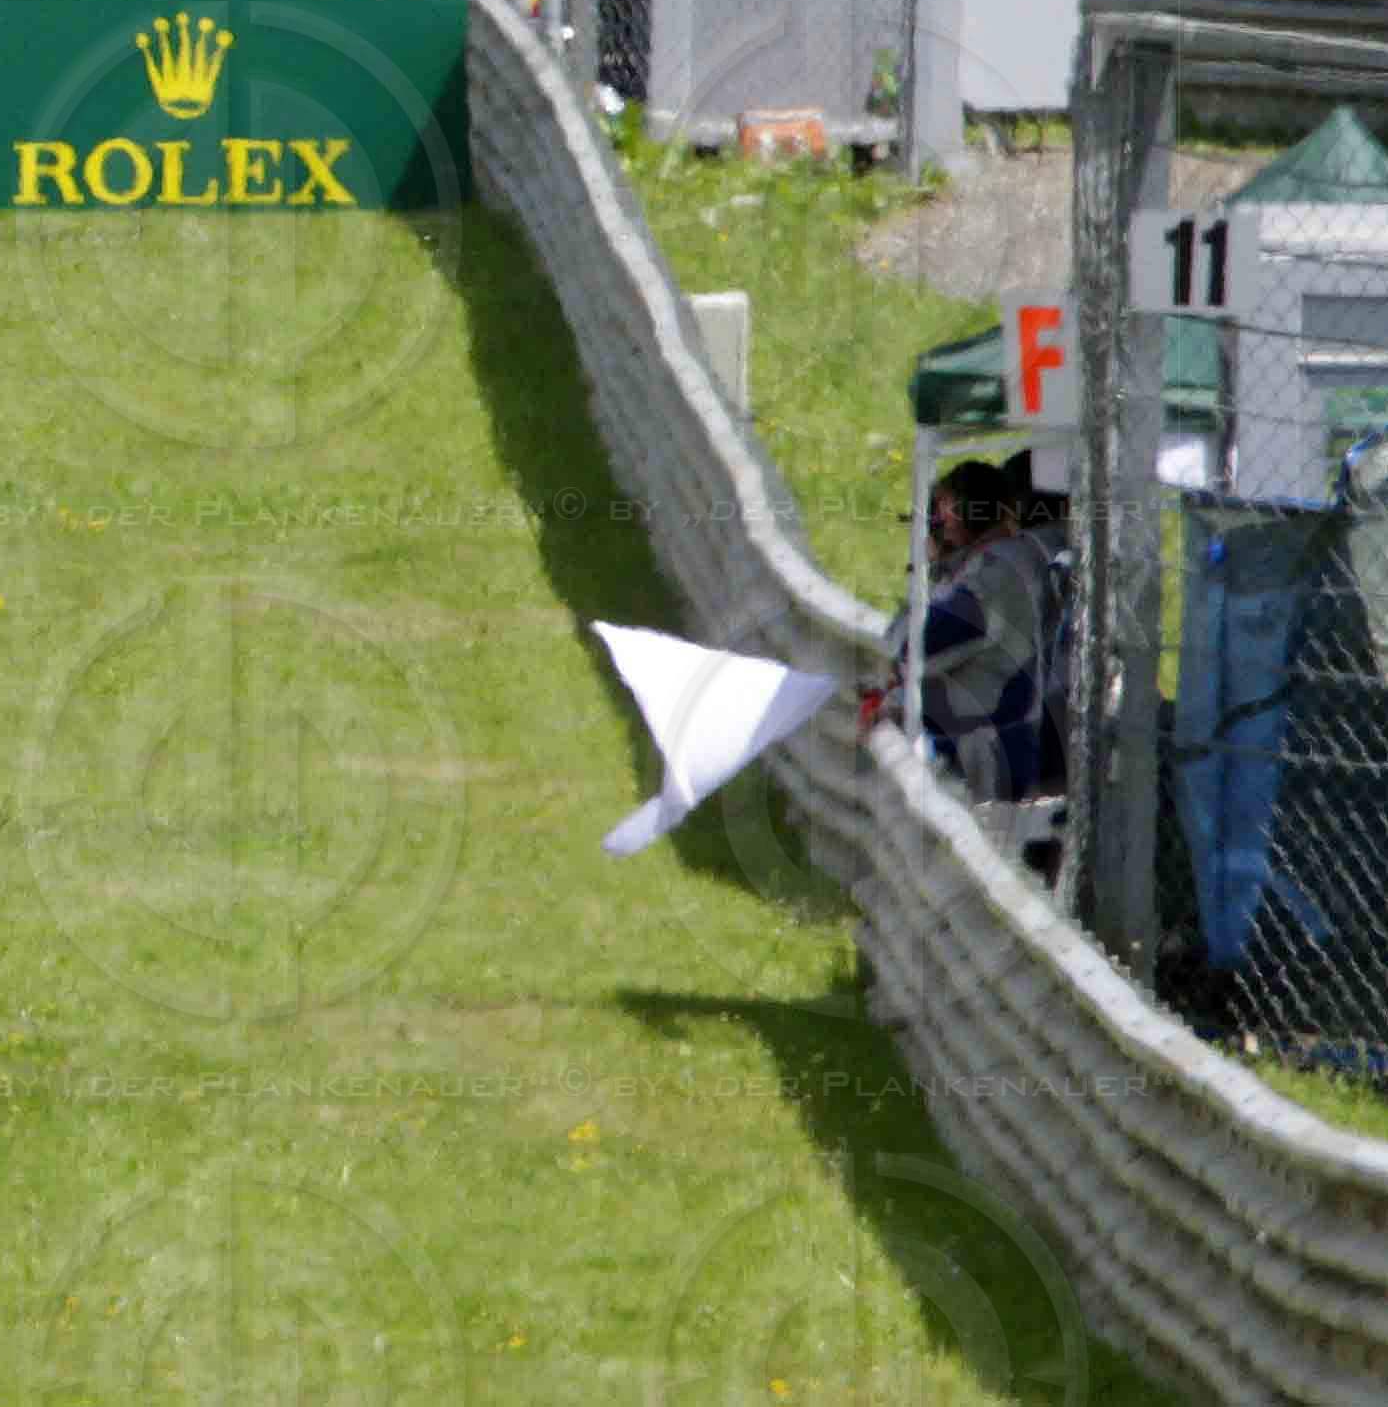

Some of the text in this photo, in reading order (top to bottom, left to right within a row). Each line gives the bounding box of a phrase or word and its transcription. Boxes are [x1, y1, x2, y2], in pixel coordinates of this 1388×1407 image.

[12, 138, 357, 206] ROLEX
[1164, 219, 1228, 305] 11
[1018, 305, 1065, 414] F
